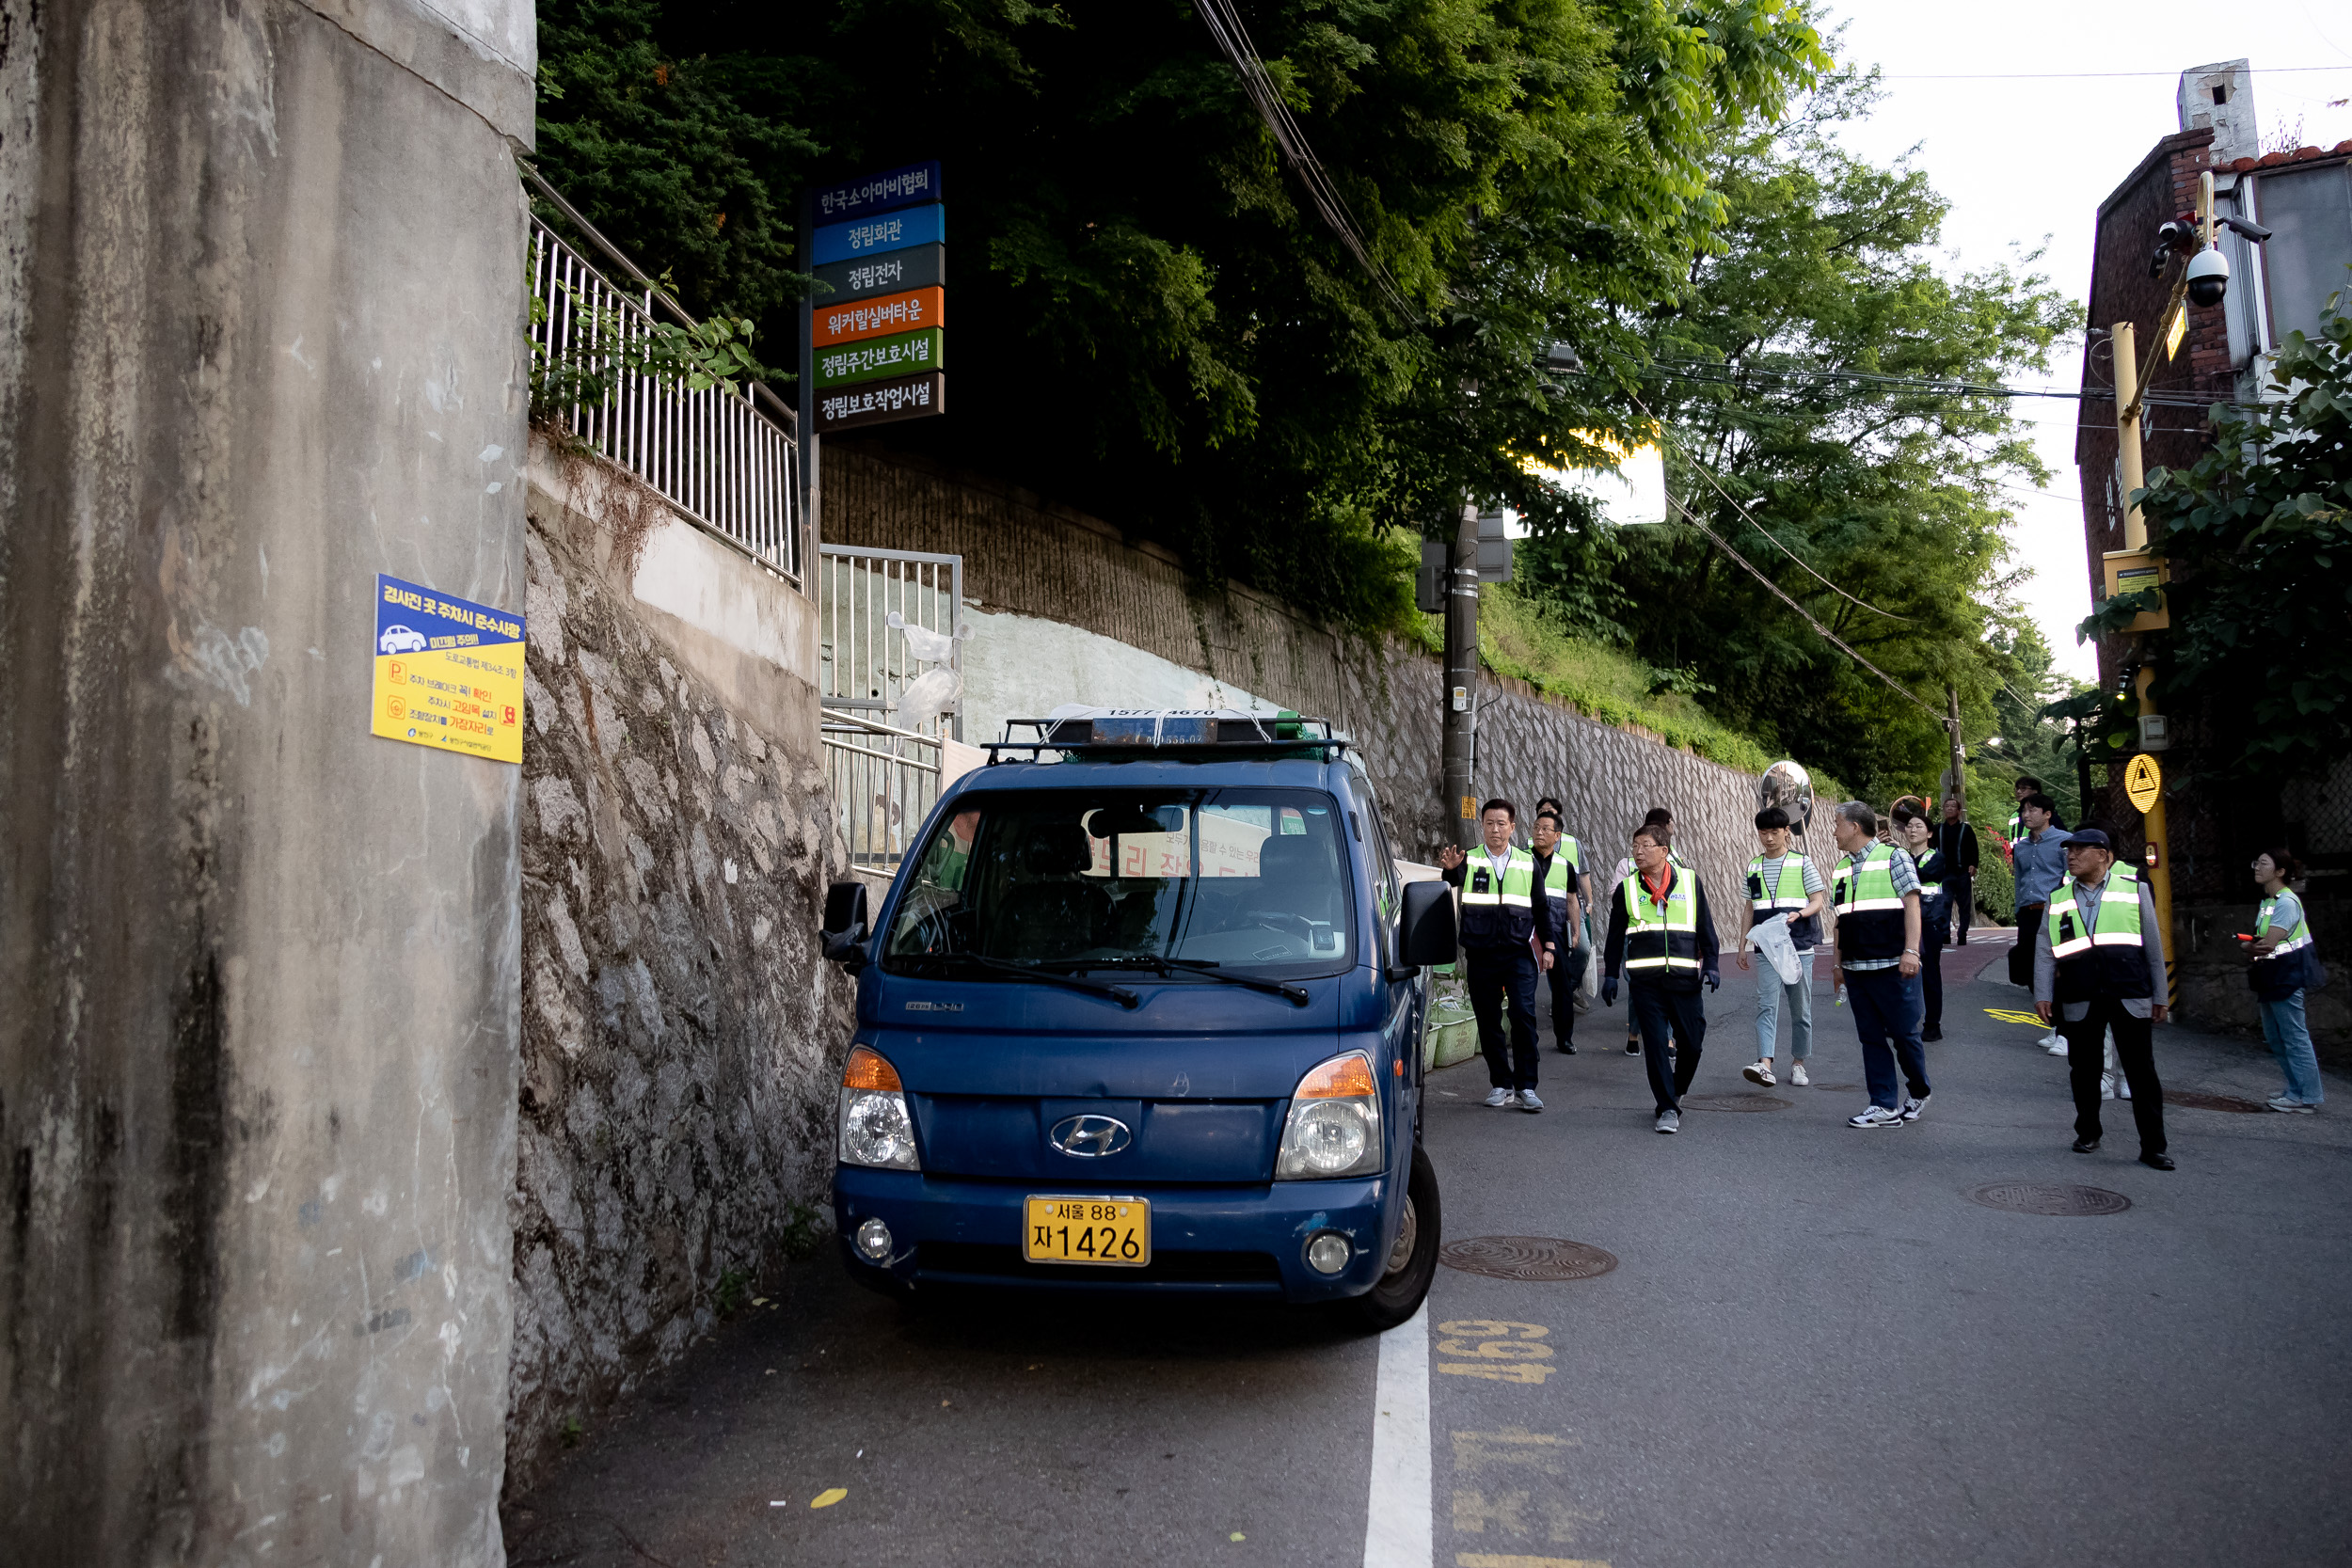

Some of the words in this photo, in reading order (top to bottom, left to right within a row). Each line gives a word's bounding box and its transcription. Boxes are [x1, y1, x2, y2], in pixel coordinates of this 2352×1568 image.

[821, 169, 929, 214] 한국소아마비협회
[848, 219, 902, 249] 정립회관
[849, 261, 902, 291] 정립전자
[828, 298, 923, 335] 워커힐실버타운
[821, 338, 929, 378] 정립주간보호시설
[821, 381, 930, 420] 정립보호작업시설
[384, 585, 421, 611] 경사진
[423, 597, 437, 615] 곳
[437, 601, 473, 626] 주차시
[475, 613, 520, 640] 준수사항
[429, 635, 456, 649] 미끄럼
[445, 651, 480, 670] 도로교통법
[409, 674, 425, 686] 주차
[427, 678, 457, 694] 브레이크
[473, 688, 492, 703] 확인
[427, 695, 451, 709] 주차시
[452, 699, 481, 717] 고임목
[482, 709, 497, 720] 설치
[449, 715, 494, 736] 가장자리로
[1200, 838, 1217, 854] 용할
[1057, 1204, 1084, 1221] 서울
[1091, 1205, 1117, 1221] 88
